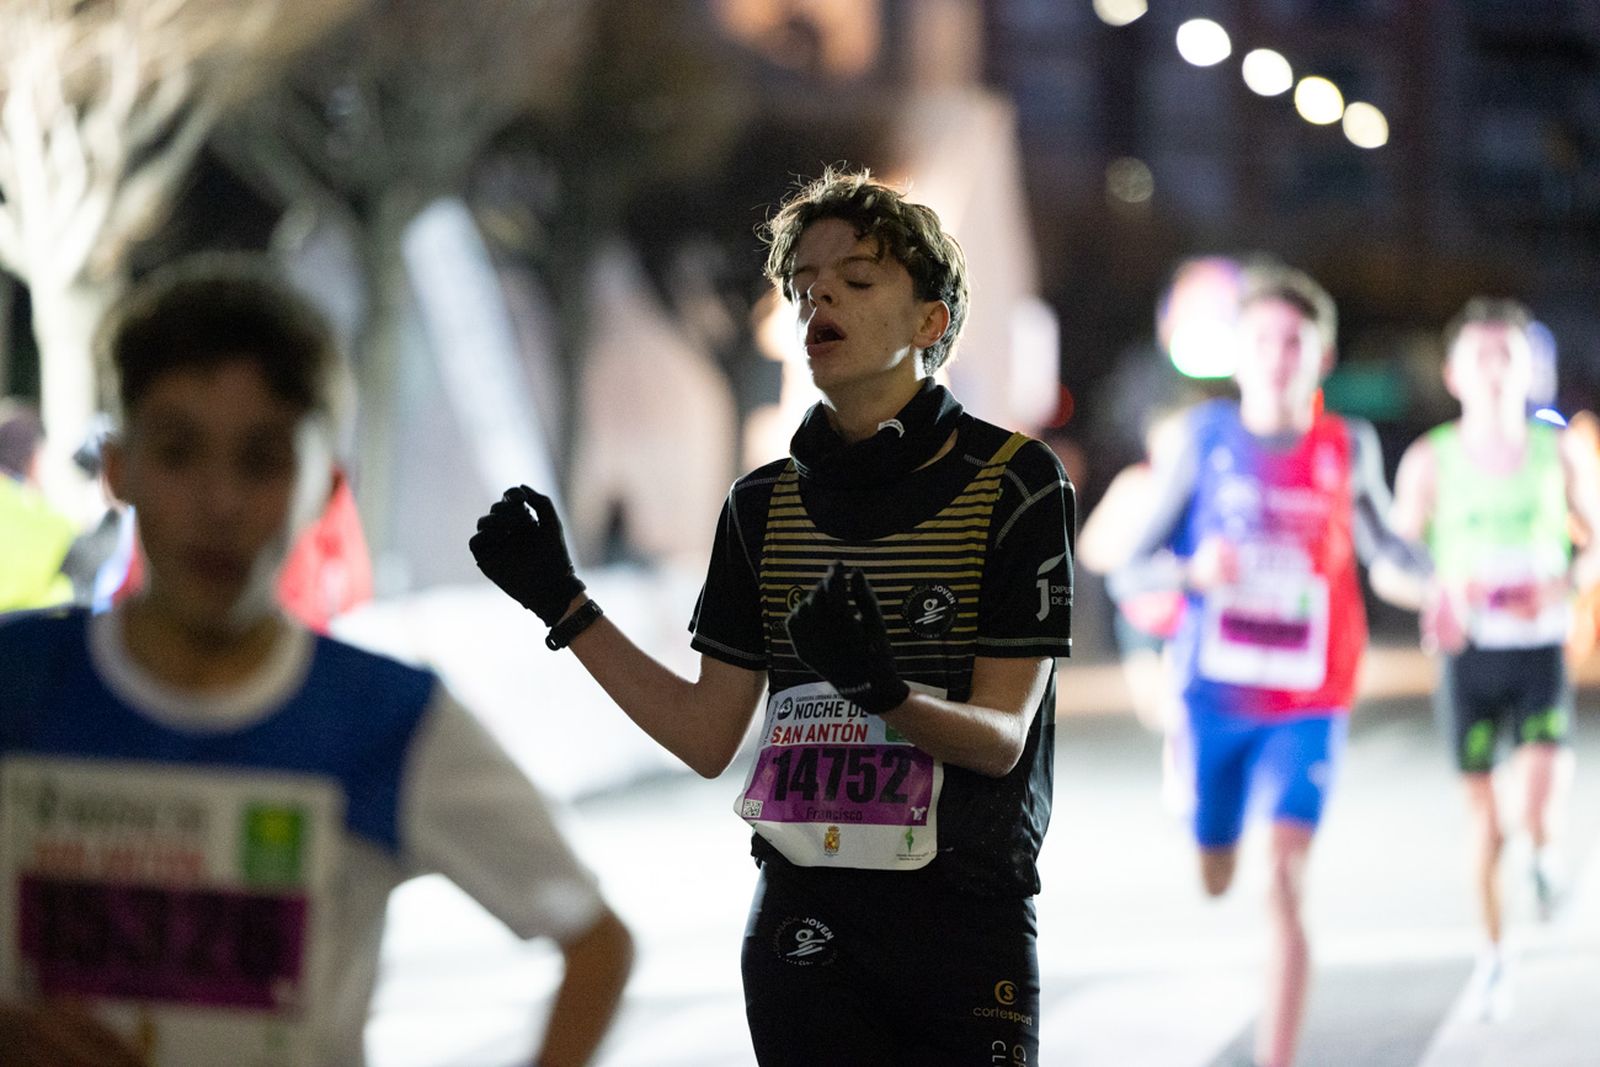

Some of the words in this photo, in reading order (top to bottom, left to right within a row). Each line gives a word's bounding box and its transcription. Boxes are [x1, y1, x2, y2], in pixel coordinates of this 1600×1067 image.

[932, 584, 957, 604] JOVEN
[794, 701, 845, 720] NOCHE
[771, 725, 804, 744] SAN
[805, 719, 868, 743] ANTÓN
[773, 748, 909, 804] 14752
[803, 917, 834, 940] JOVEN
